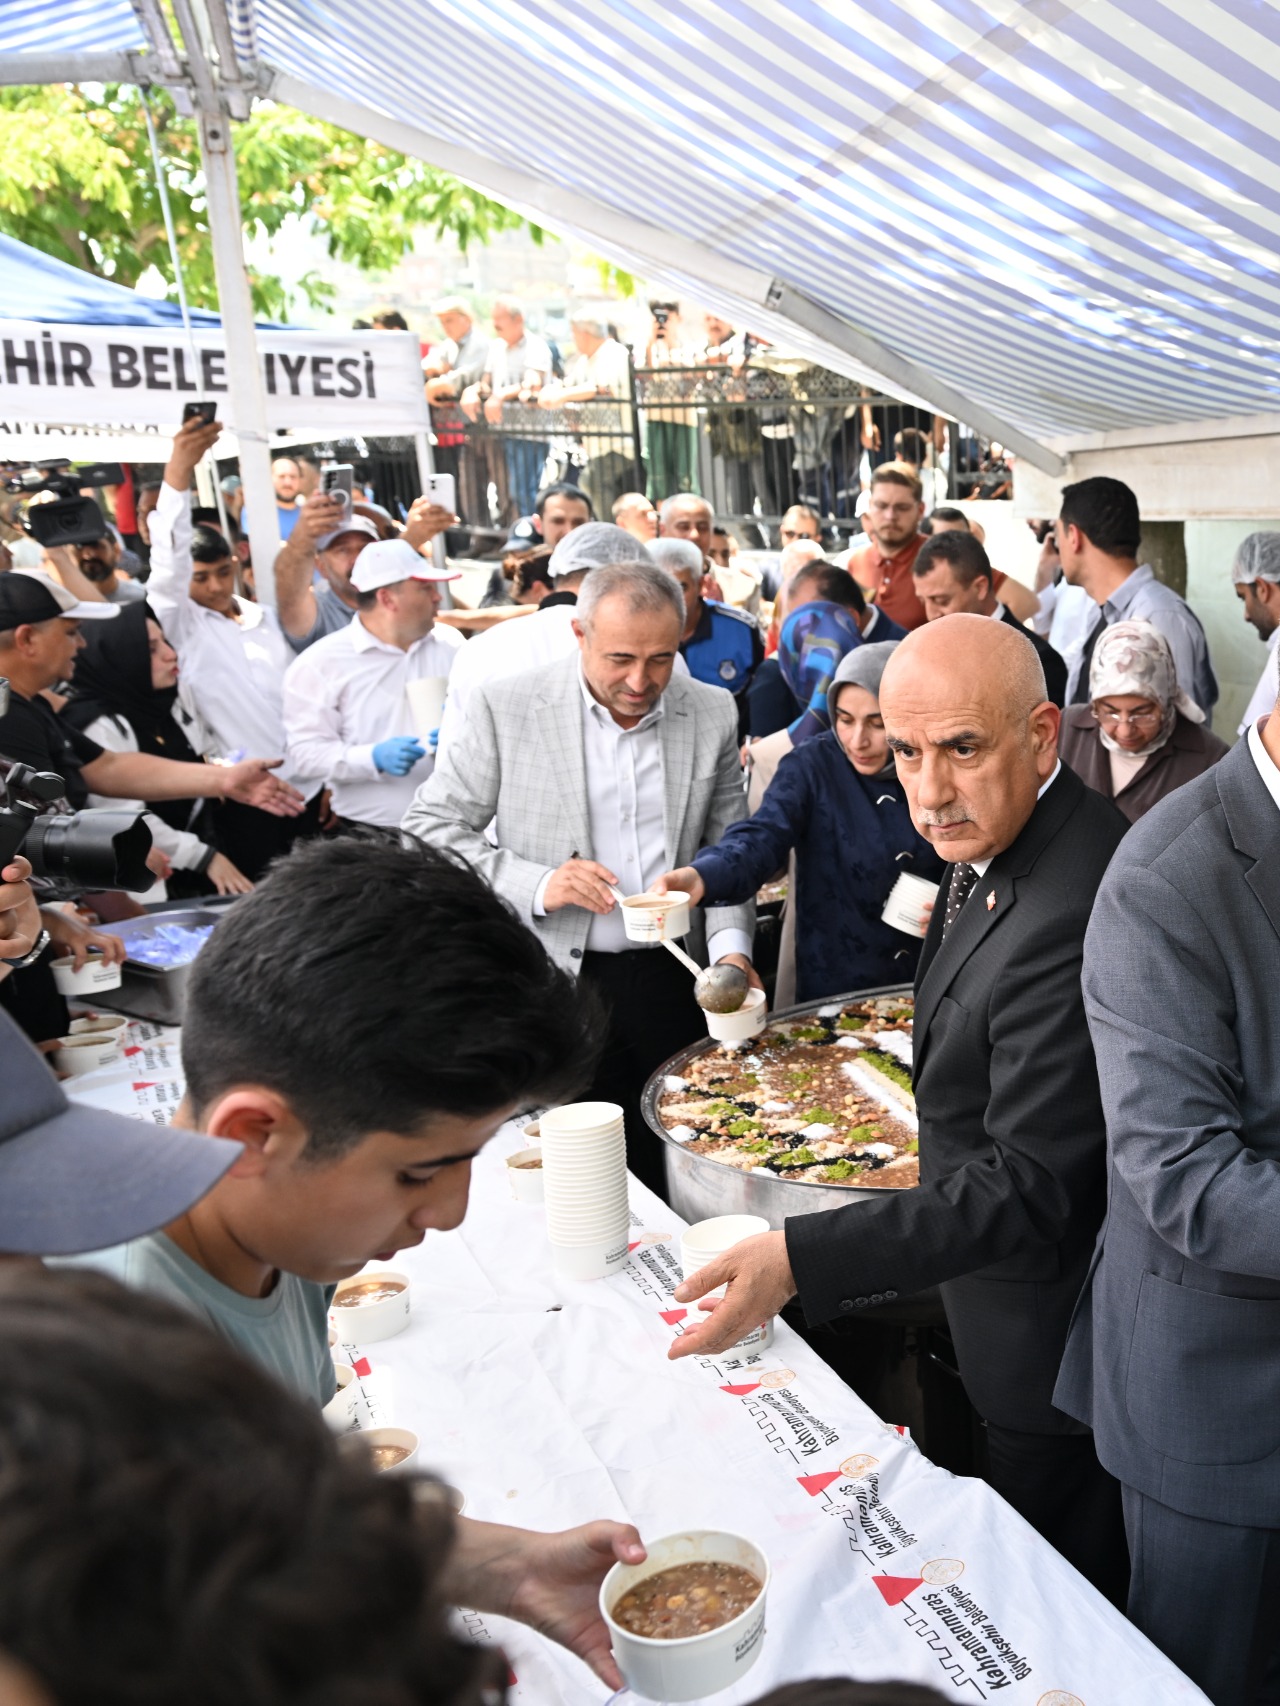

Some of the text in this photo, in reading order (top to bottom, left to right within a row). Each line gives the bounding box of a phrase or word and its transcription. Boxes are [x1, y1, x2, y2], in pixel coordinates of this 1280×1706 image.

[0, 330, 95, 388] HİR
[922, 1593, 1012, 1690] Kahramanmaraş
[941, 1583, 1032, 1681] Büyükşehir Belediyesi
